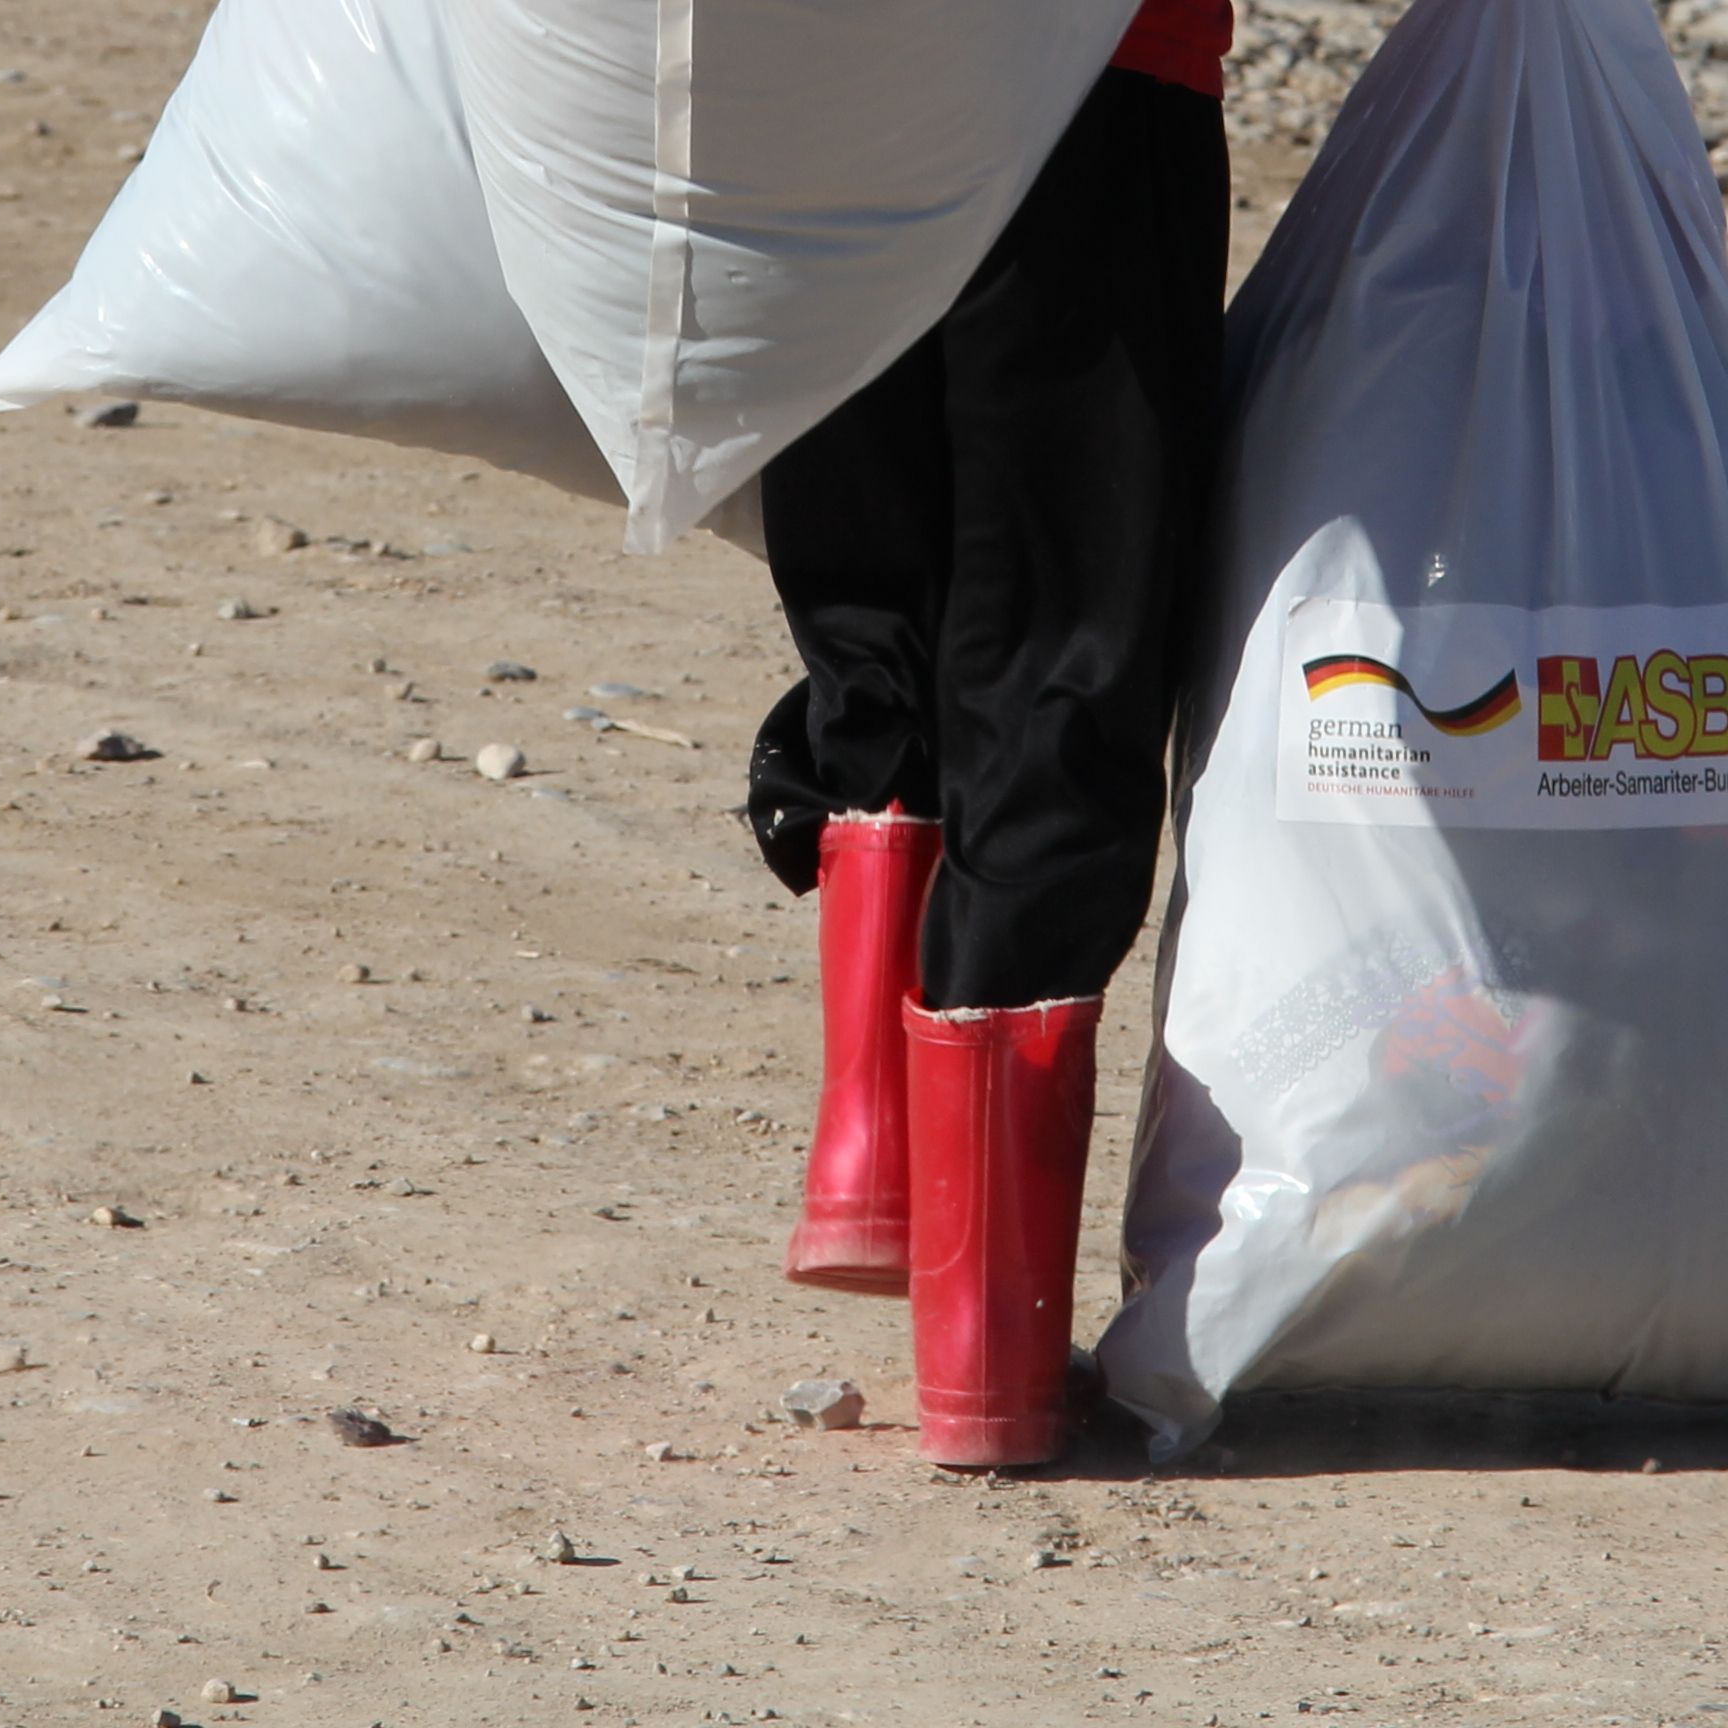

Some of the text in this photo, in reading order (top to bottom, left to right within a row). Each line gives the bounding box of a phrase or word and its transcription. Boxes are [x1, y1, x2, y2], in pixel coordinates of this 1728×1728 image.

[1309, 718, 1403, 740] german
[1308, 741, 1431, 762] humanitarian
[1308, 762, 1401, 780] assistance
[1307, 782, 1362, 795] DEUTSCHE
